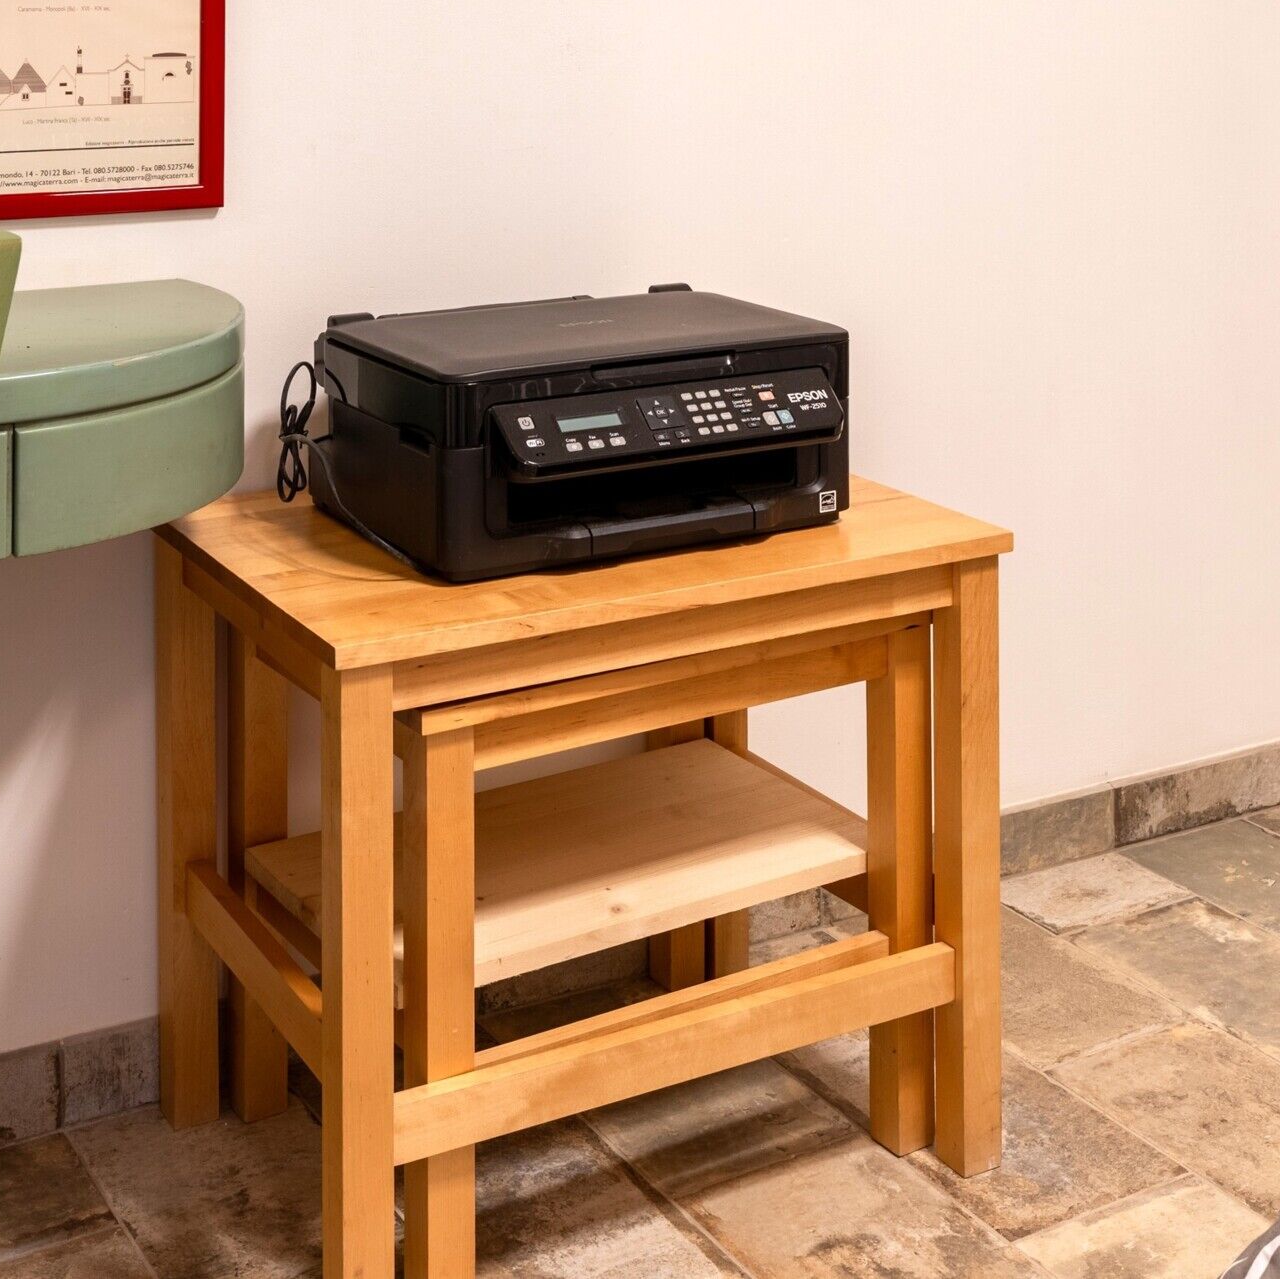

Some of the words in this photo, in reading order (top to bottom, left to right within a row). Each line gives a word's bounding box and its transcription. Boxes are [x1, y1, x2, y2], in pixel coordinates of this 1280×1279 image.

[154, 163, 194, 171] 080.5275746
[107, 172, 194, 183] magicaterra@magicaterra.it
[787, 389, 828, 403] EPSON
[800, 402, 827, 411] WF-2510
